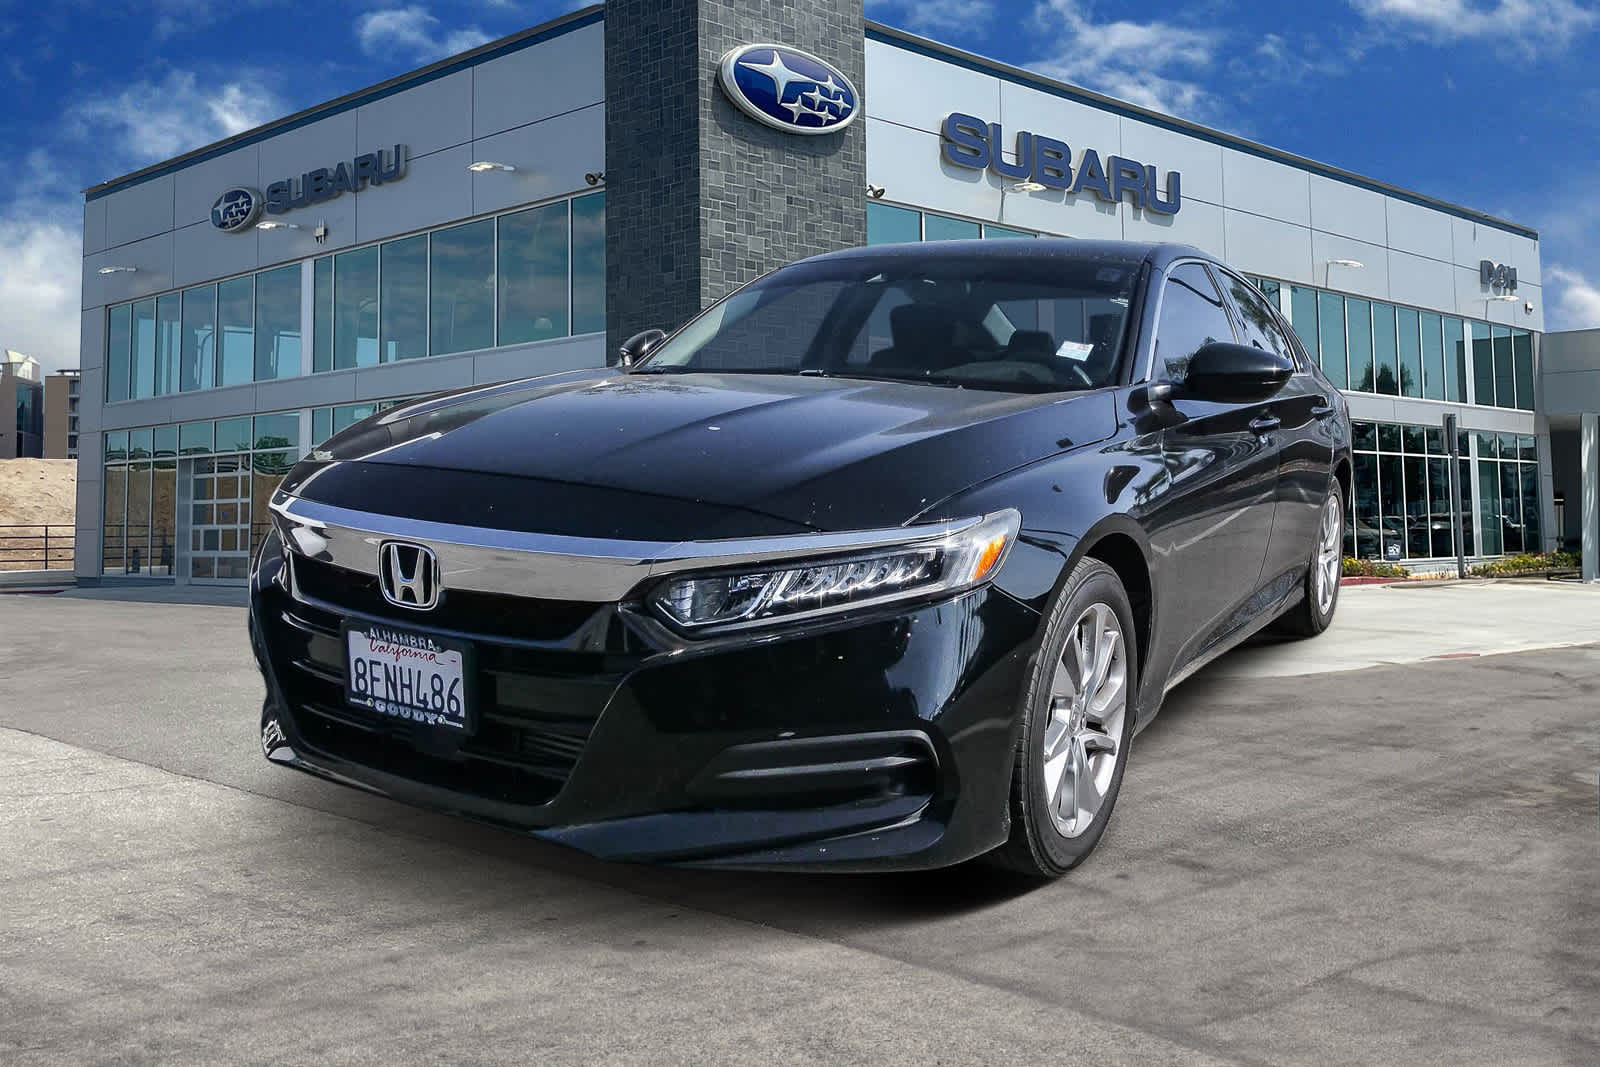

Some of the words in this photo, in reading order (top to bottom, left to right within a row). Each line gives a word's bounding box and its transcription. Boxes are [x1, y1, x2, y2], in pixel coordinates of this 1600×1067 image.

[266, 144, 408, 215] SUBARU
[940, 112, 1182, 216] SUBARU
[369, 627, 436, 652] ALHAMBRA
[369, 638, 446, 665] California
